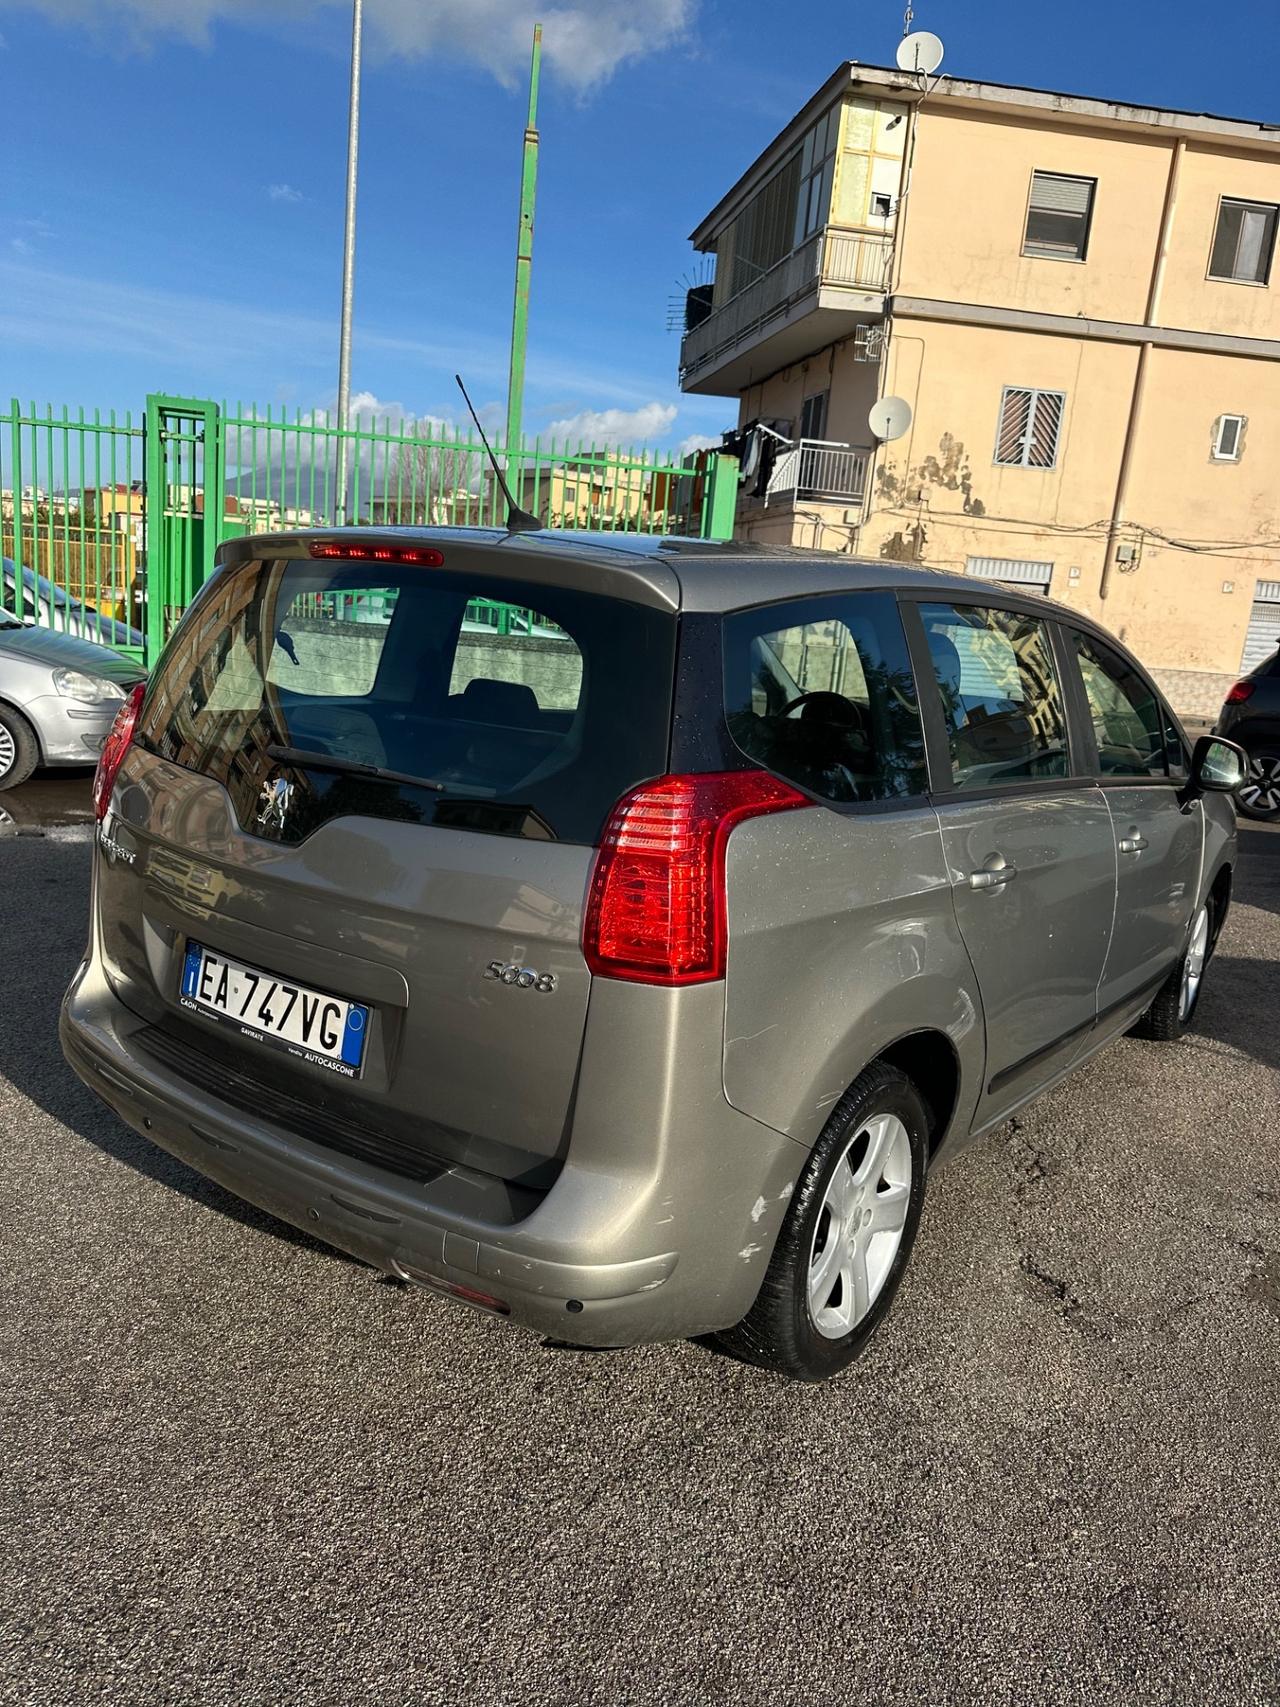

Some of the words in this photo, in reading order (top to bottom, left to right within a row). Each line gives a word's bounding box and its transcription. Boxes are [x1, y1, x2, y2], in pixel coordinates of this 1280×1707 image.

[483, 960, 557, 994] 5008
[180, 998, 198, 1011] CAON
[200, 954, 229, 1009] EA
[239, 972, 341, 1050] 747VG
[304, 1053, 355, 1078] AUTOCASCONE
